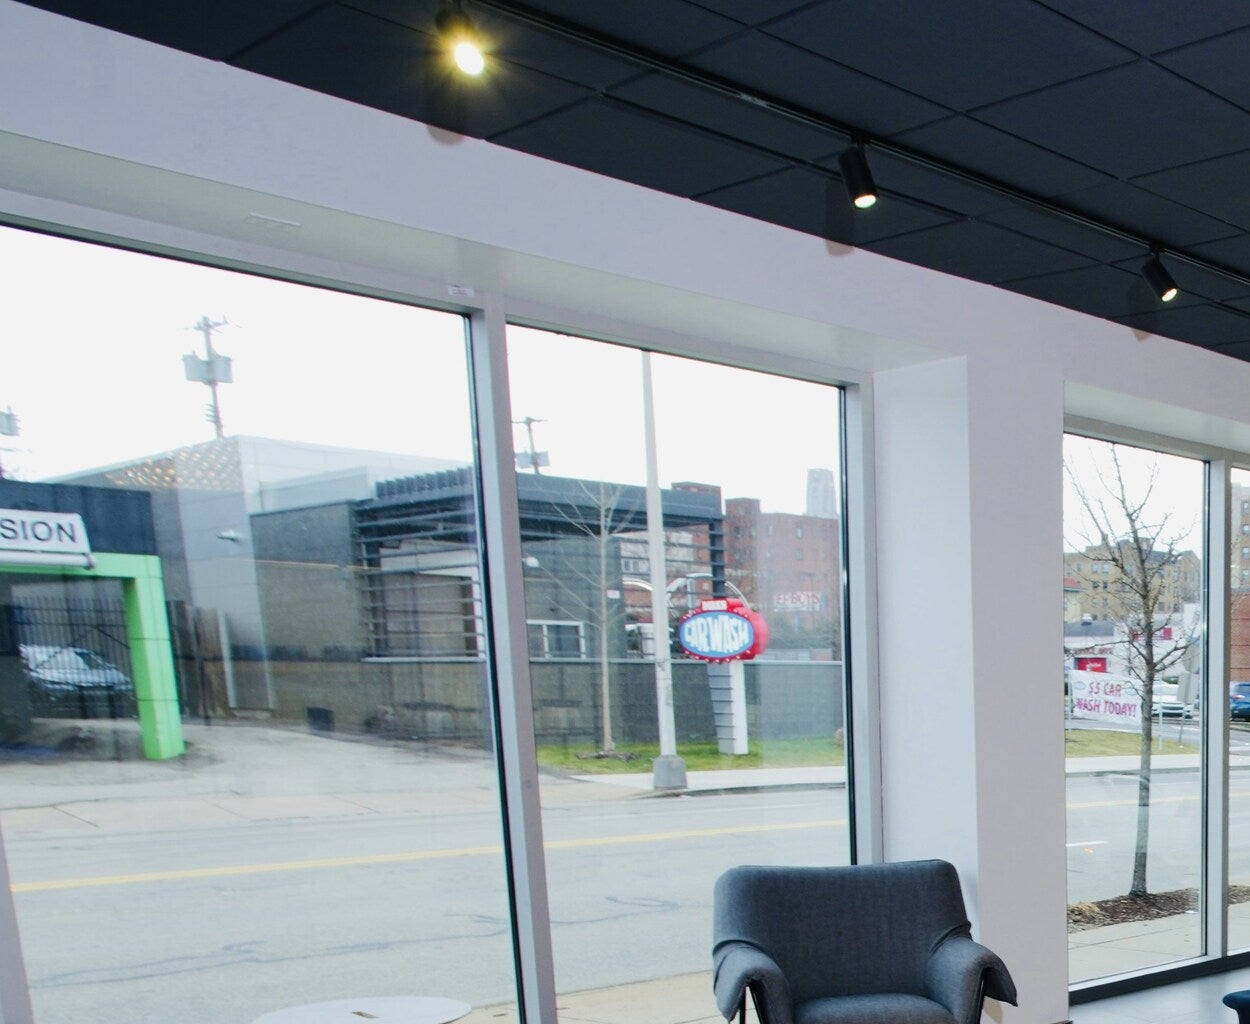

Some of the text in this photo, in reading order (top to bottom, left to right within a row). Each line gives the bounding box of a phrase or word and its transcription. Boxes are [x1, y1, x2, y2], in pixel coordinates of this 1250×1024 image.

[0, 518, 77, 543] SION
[684, 614, 749, 653] CAR WASH
[1103, 682, 1122, 697] CAR
[1075, 697, 1137, 717] WASH TODAY!
